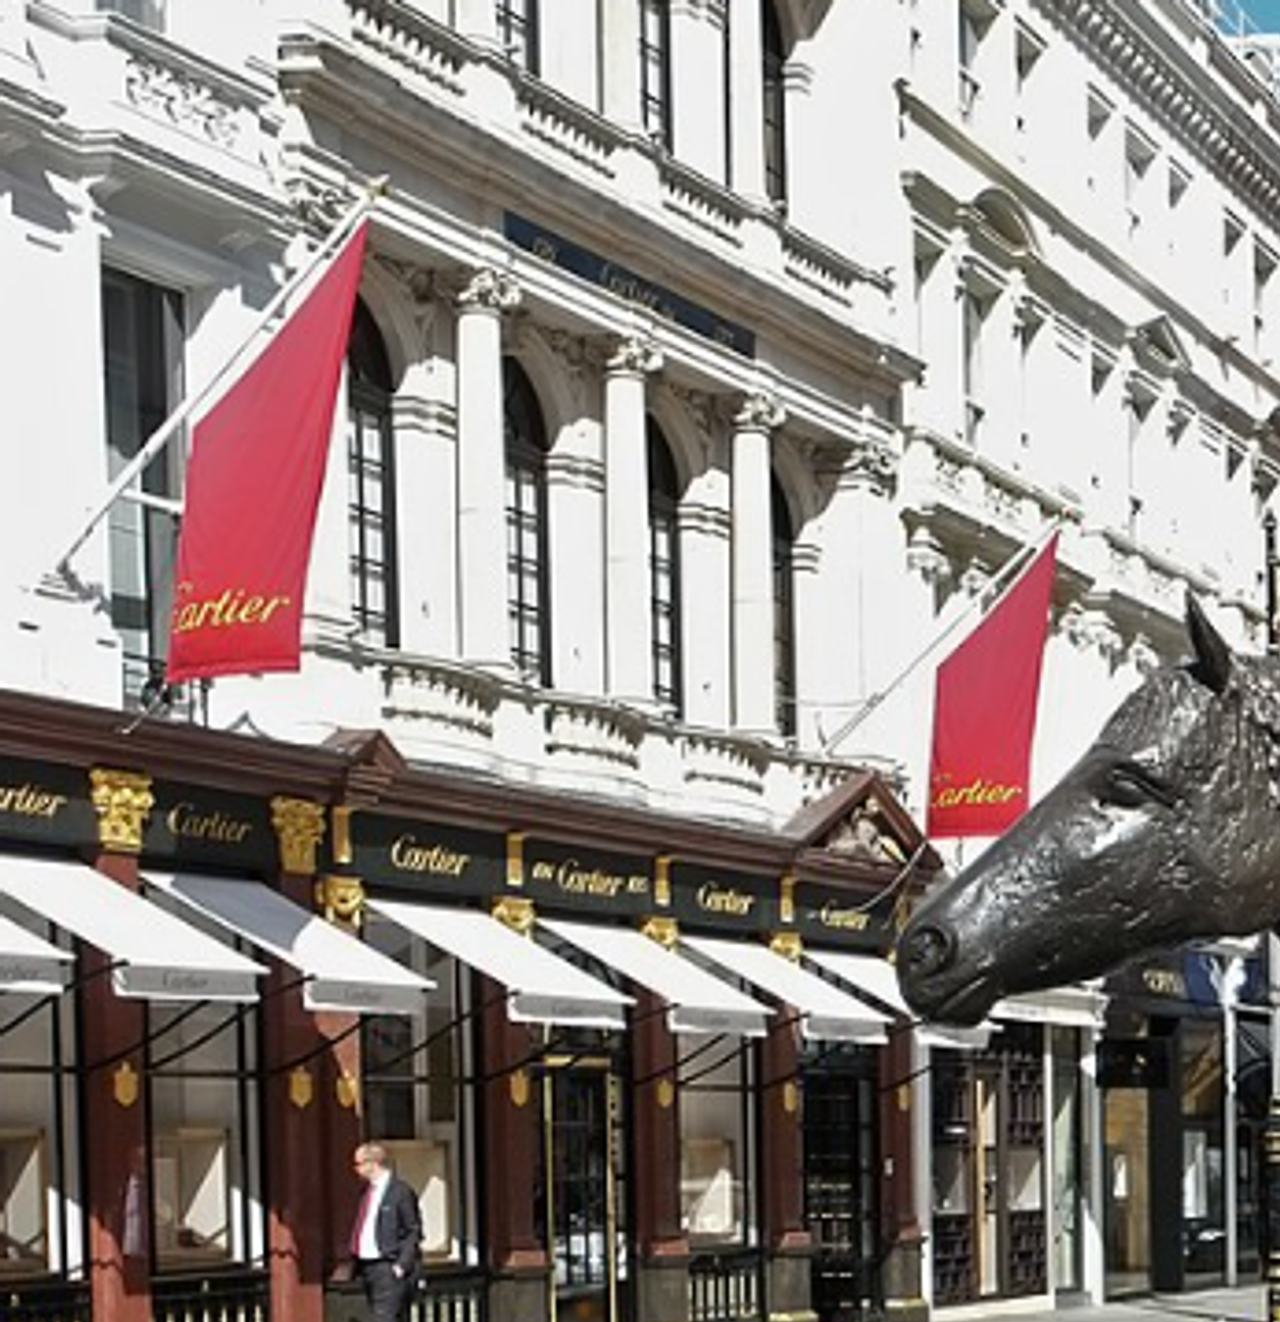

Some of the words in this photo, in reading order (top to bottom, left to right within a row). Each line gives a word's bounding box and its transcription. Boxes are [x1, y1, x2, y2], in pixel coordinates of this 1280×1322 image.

[932, 772, 1023, 808] artier
[166, 802, 252, 843] Cartier
[391, 833, 471, 876] Cartier
[558, 858, 625, 897] Cartier
[696, 880, 757, 916] Cartier
